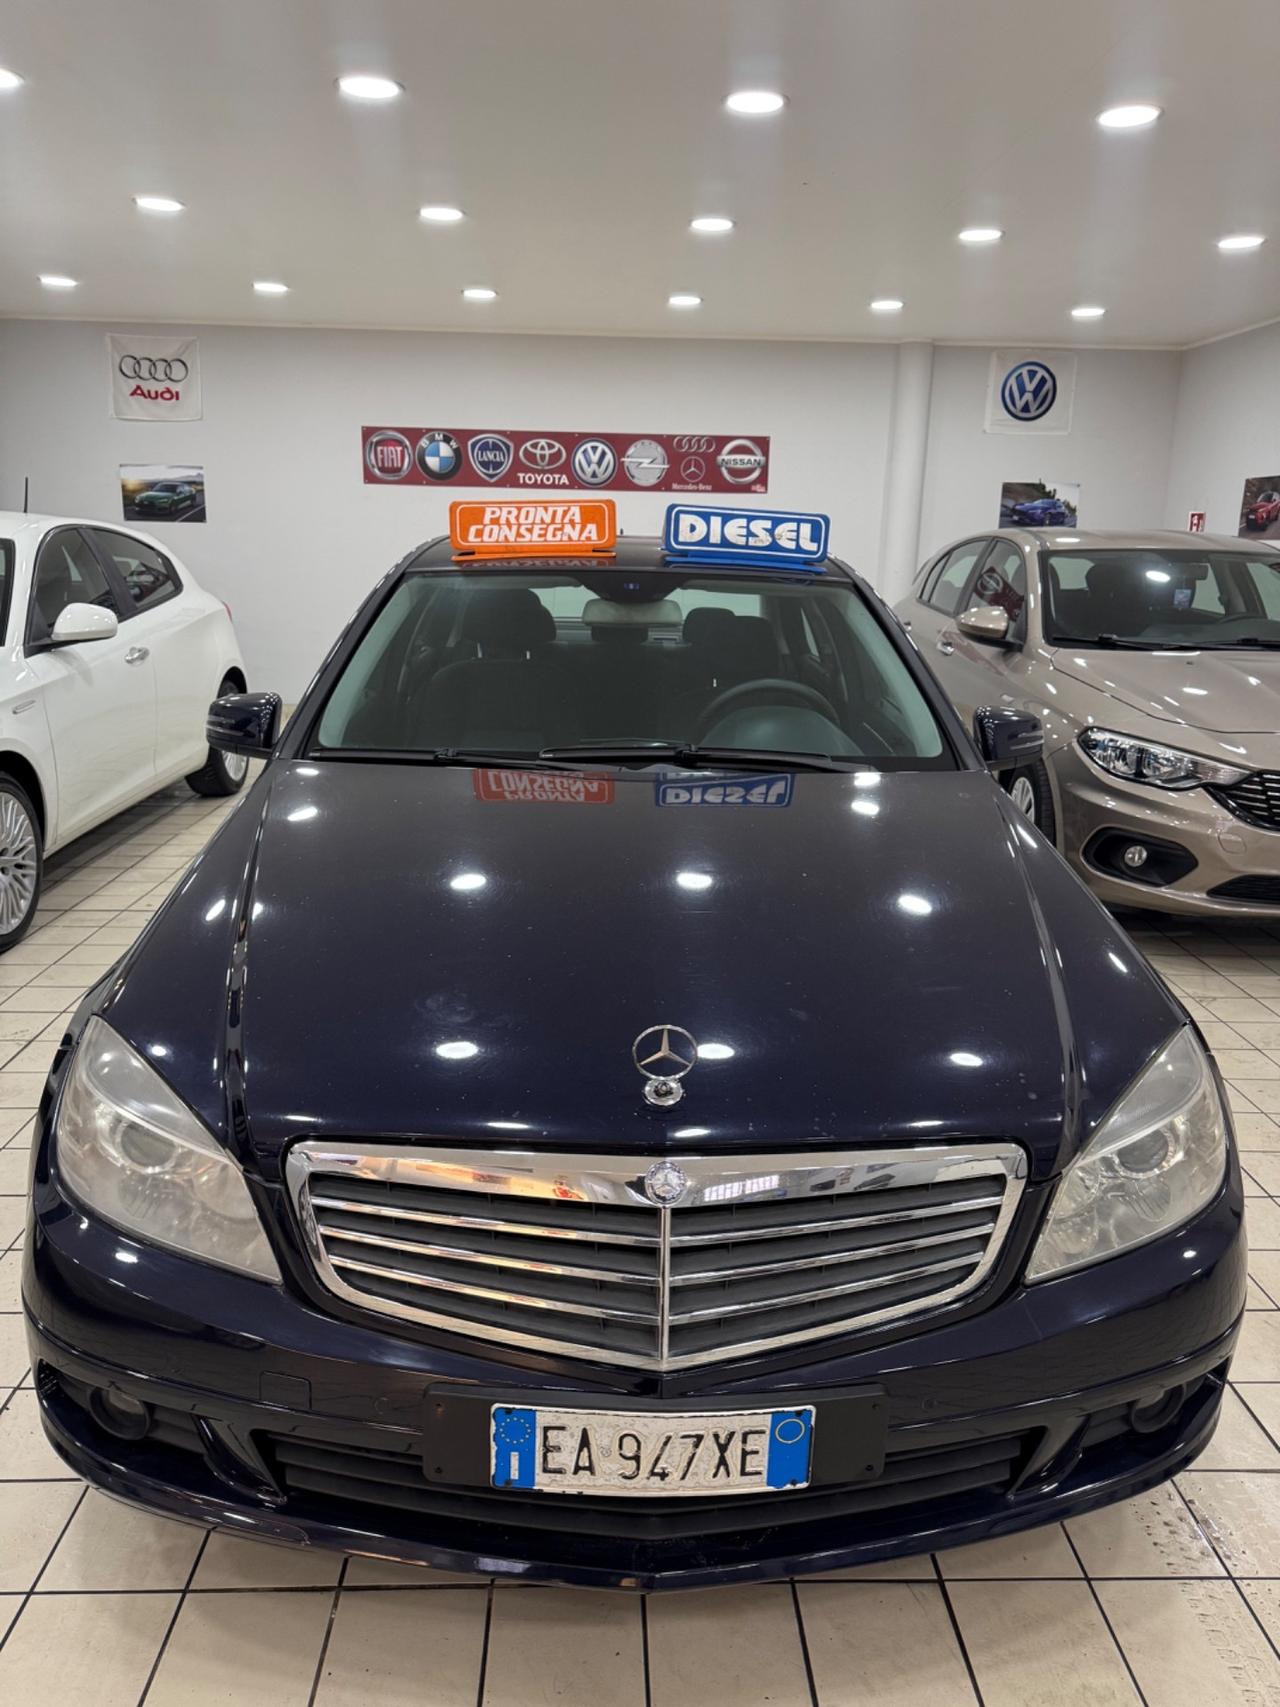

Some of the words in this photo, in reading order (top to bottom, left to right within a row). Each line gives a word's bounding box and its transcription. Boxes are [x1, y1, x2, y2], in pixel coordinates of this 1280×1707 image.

[129, 384, 180, 401] Audi
[421, 433, 458, 449] BMW
[376, 445, 403, 468] FIAT
[478, 450, 505, 462] LANCIA
[720, 457, 761, 467] NISSAN
[517, 472, 569, 486] TOYOTA
[483, 505, 582, 525] PRONTA
[467, 523, 599, 543] CONSEGNA
[678, 513, 819, 551] DIESEL
[542, 1425, 596, 1476] EA
[618, 1429, 766, 1481] 947XE
